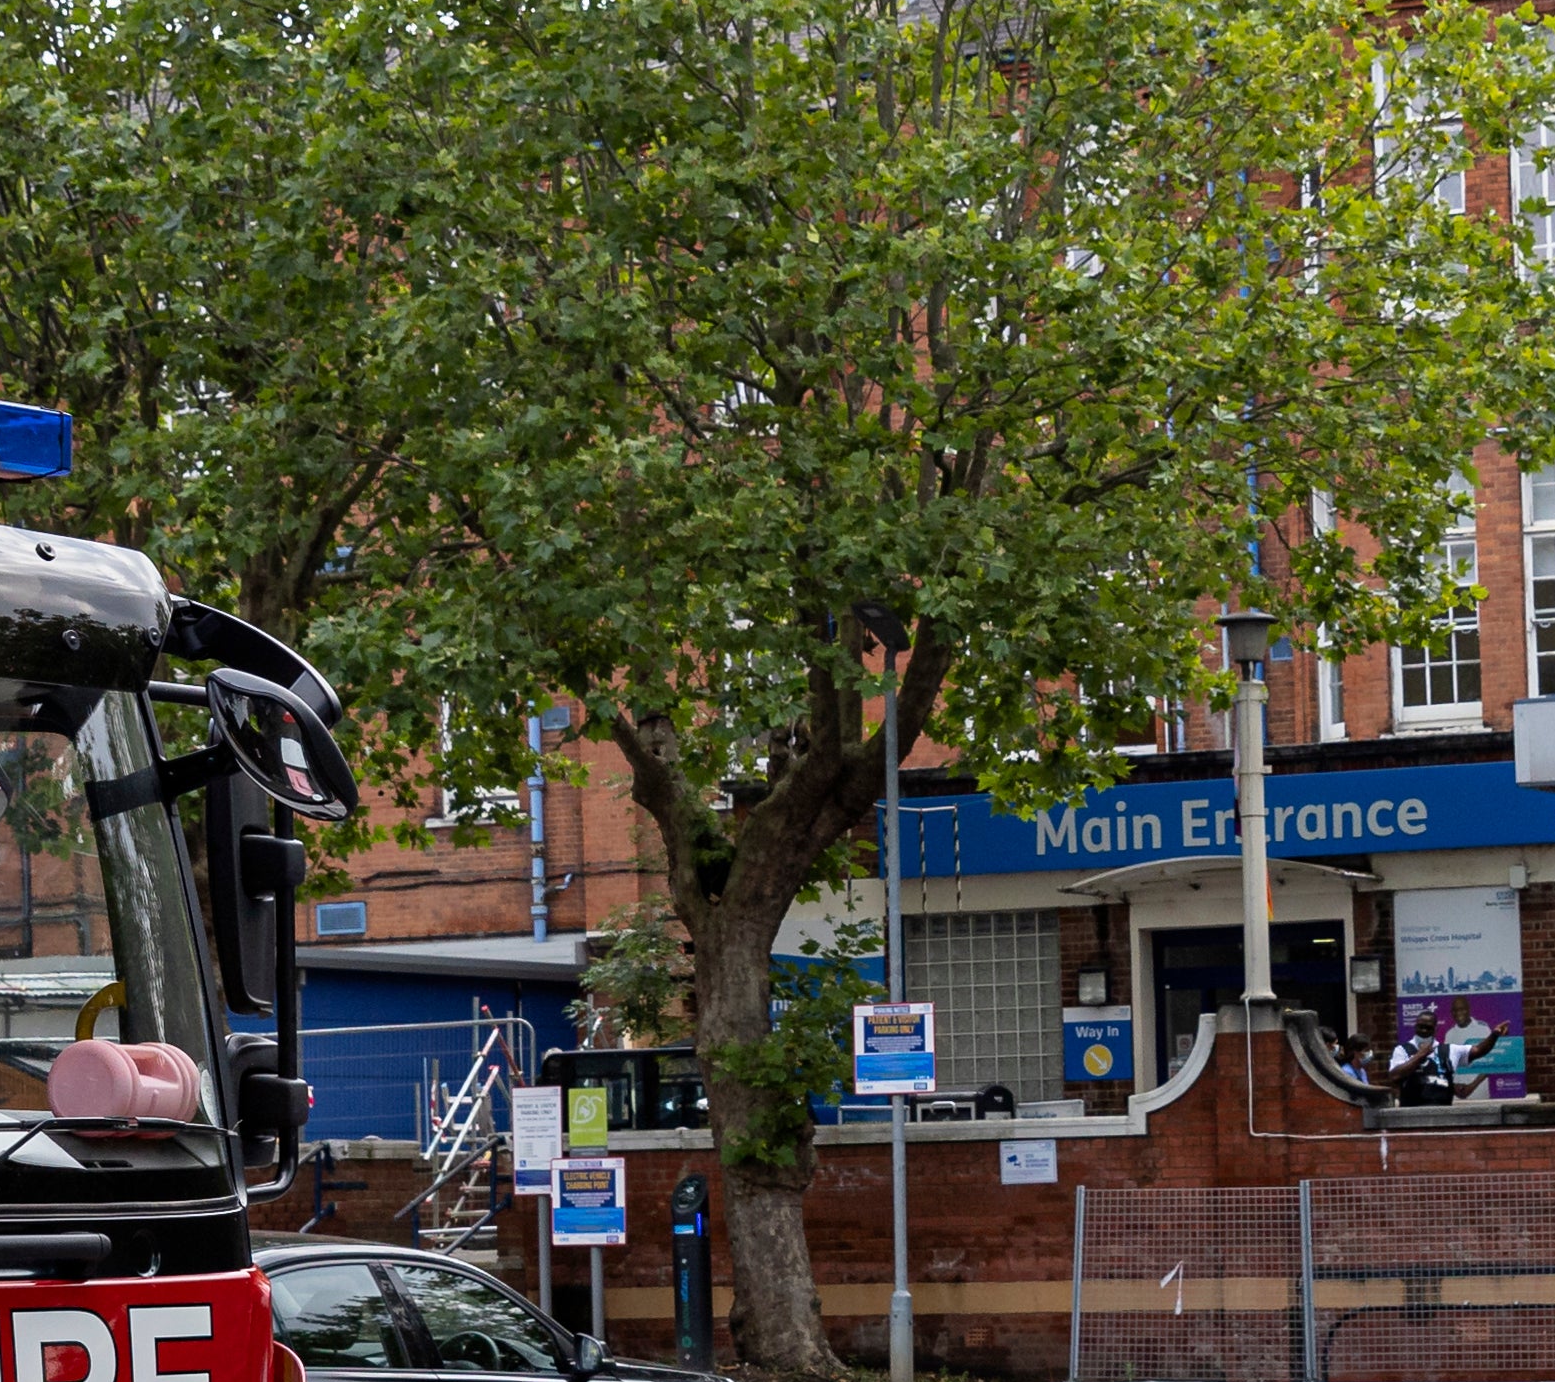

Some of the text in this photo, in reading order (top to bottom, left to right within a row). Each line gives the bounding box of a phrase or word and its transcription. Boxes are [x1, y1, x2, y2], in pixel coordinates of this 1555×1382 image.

[1035, 797, 1429, 856] Main Enrance
[1075, 1025, 1120, 1040] Way In
